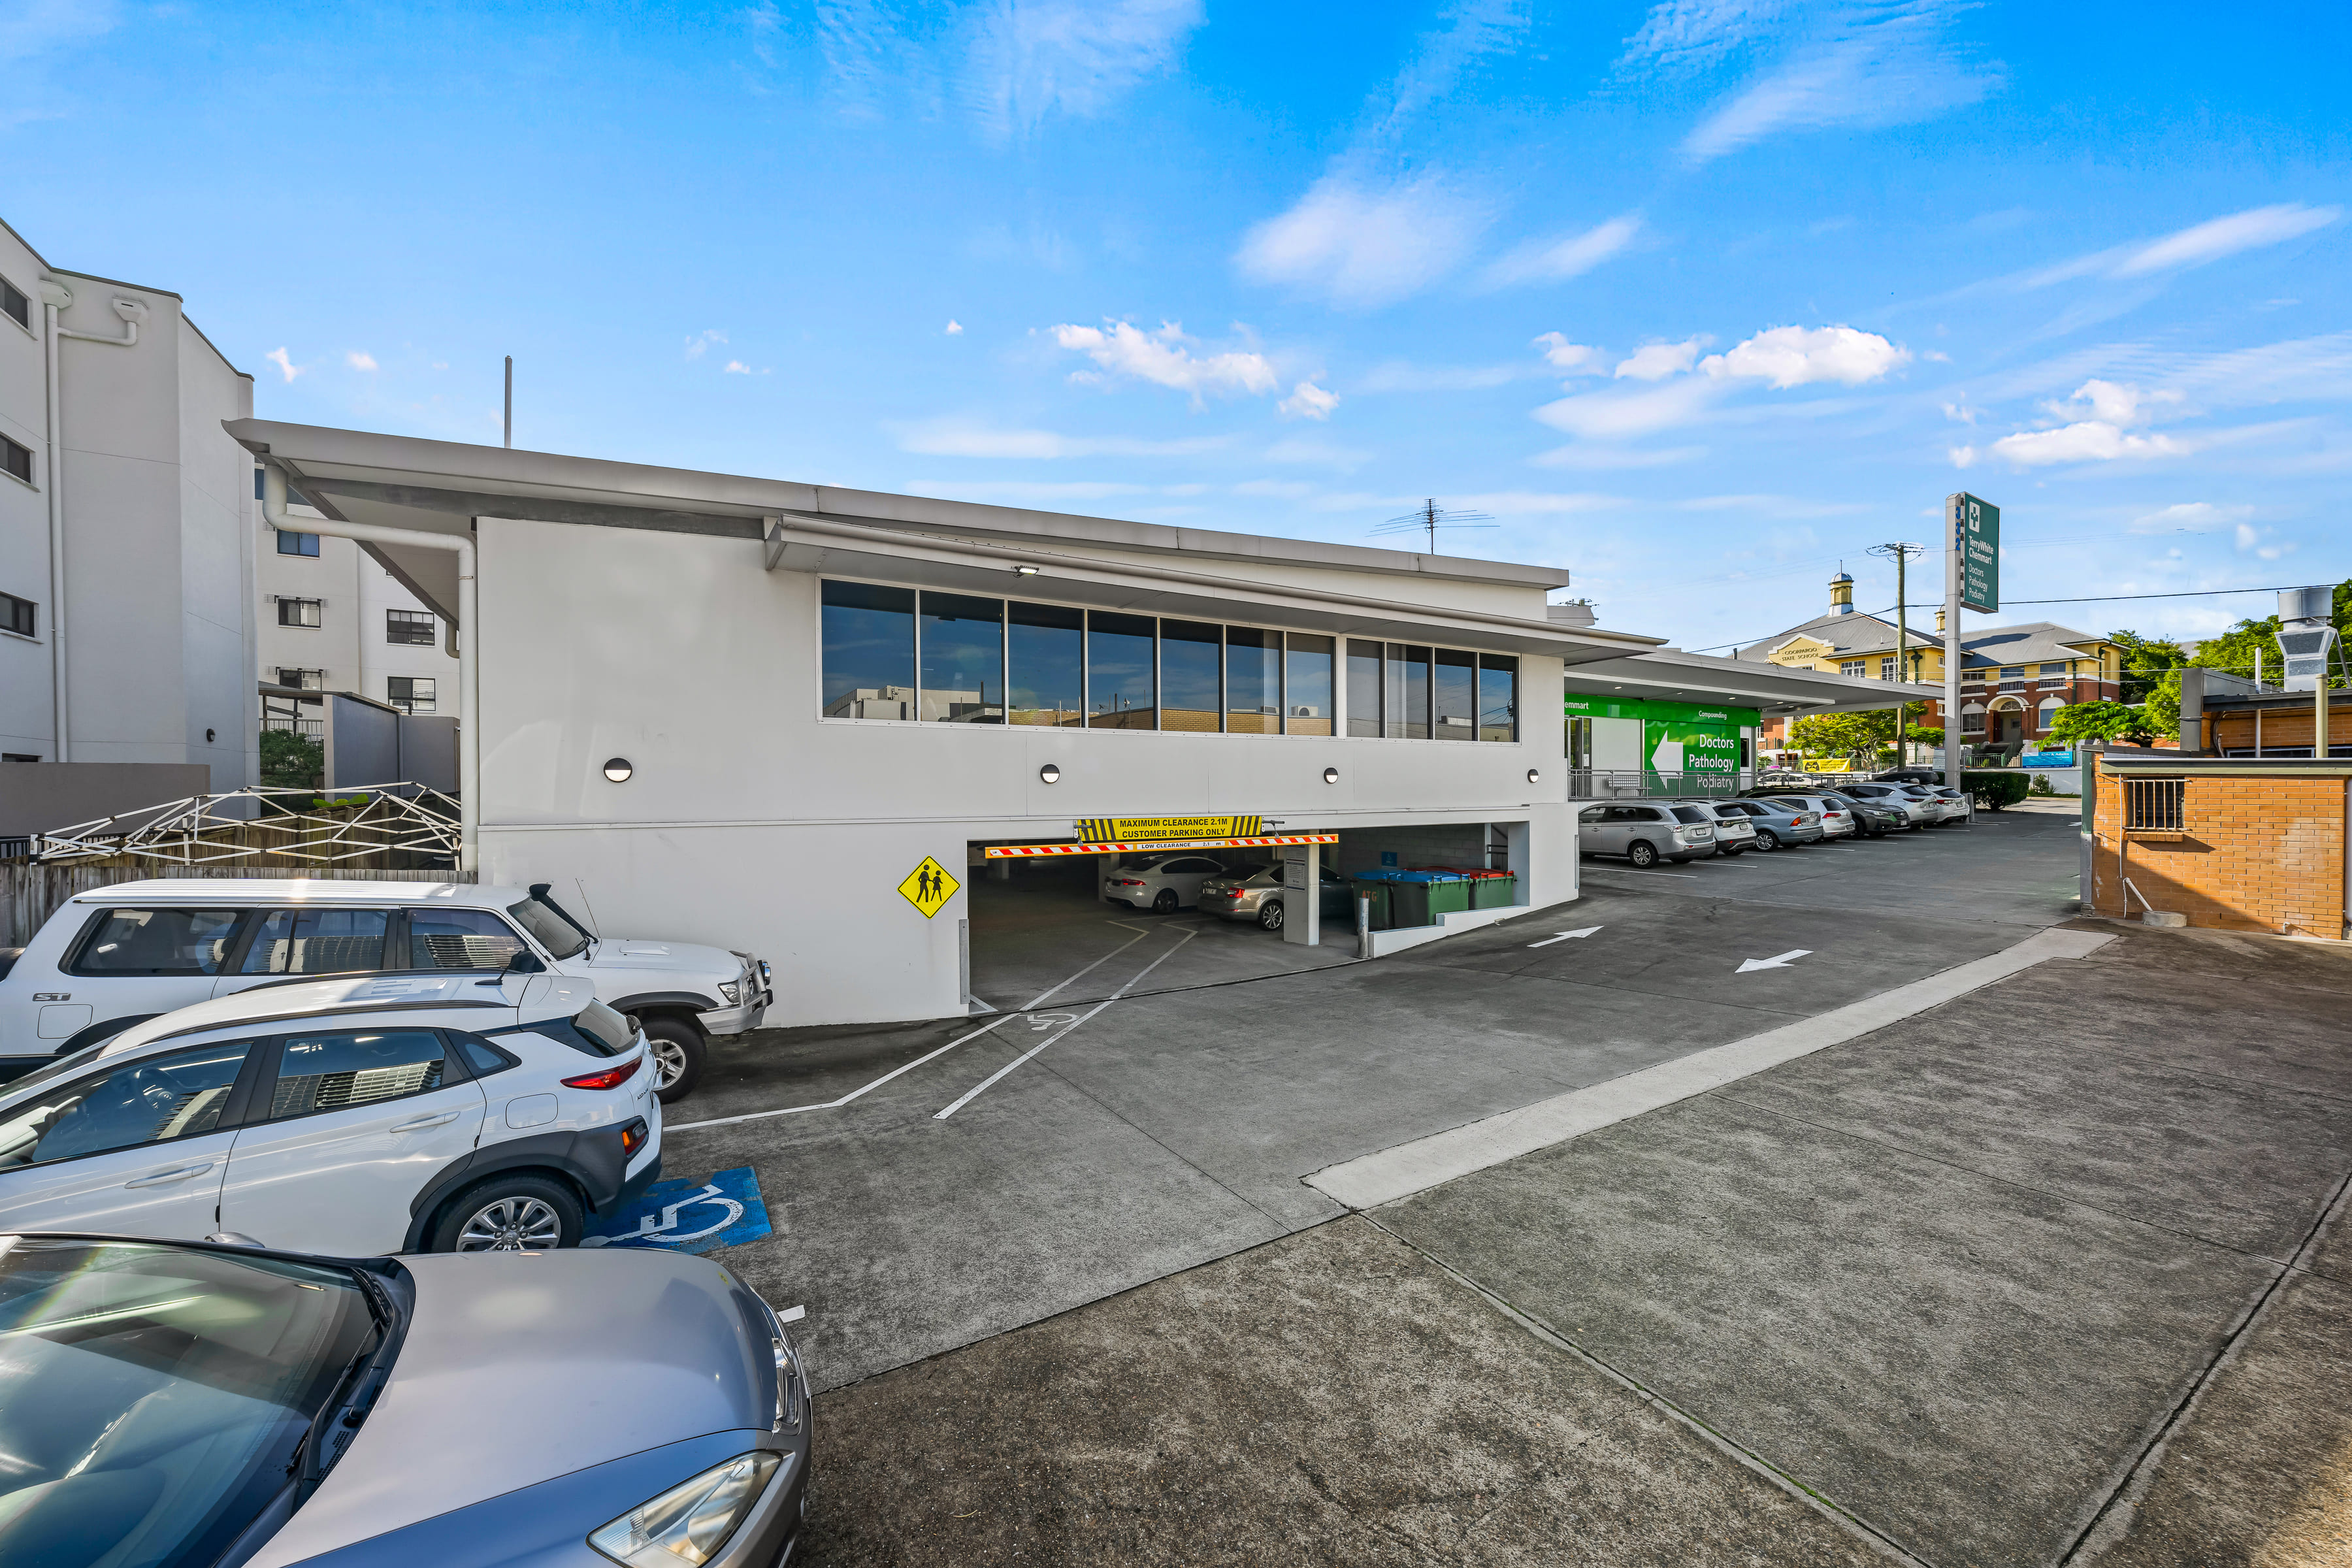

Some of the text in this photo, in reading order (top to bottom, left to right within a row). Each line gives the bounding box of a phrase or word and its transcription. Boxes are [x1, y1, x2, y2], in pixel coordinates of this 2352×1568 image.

[1968, 535, 1994, 554] TerryWhite
[1968, 547, 1992, 565] Chemmart
[1968, 563, 1984, 577] Doctors
[1968, 575, 1988, 592] Pathology
[1968, 587, 1985, 603] Podiatry
[1699, 710, 1727, 720] Compounding
[1699, 734, 1734, 749] Doctors
[1689, 753, 1734, 772] Pathology
[1697, 774, 1734, 792] Podiatry
